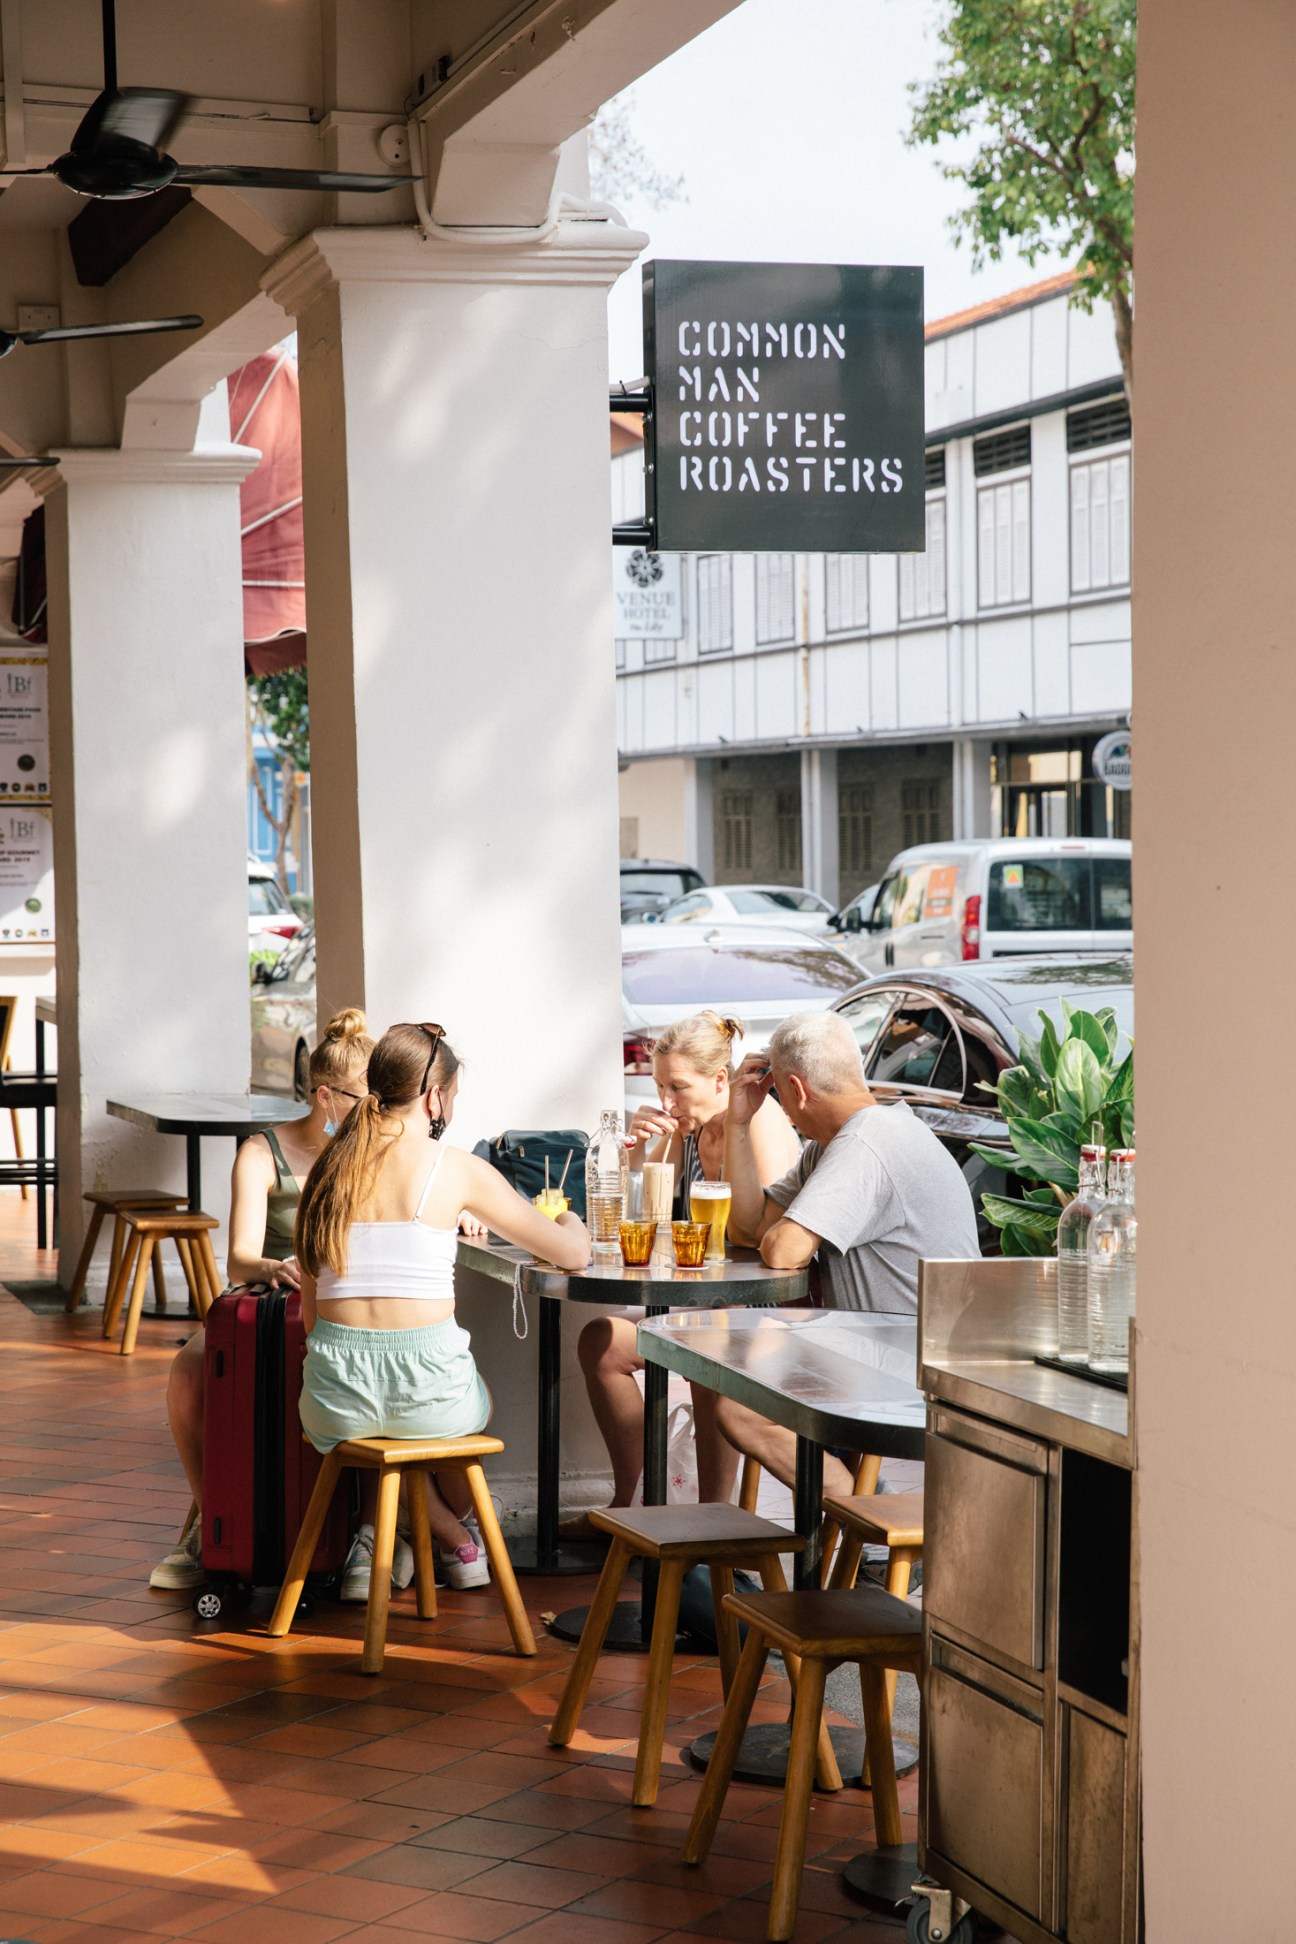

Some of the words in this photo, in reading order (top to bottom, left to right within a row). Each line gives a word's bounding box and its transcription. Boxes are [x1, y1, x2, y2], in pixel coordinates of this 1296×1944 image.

[678, 320, 846, 360] COMMON
[678, 365, 760, 403] MAN
[679, 411, 847, 449] COFFEE
[679, 455, 903, 493] ROASTERS
[617, 592, 676, 605] VENUE
[623, 608, 671, 619] HOTEL
[460, 1547, 475, 1557] NIKE
